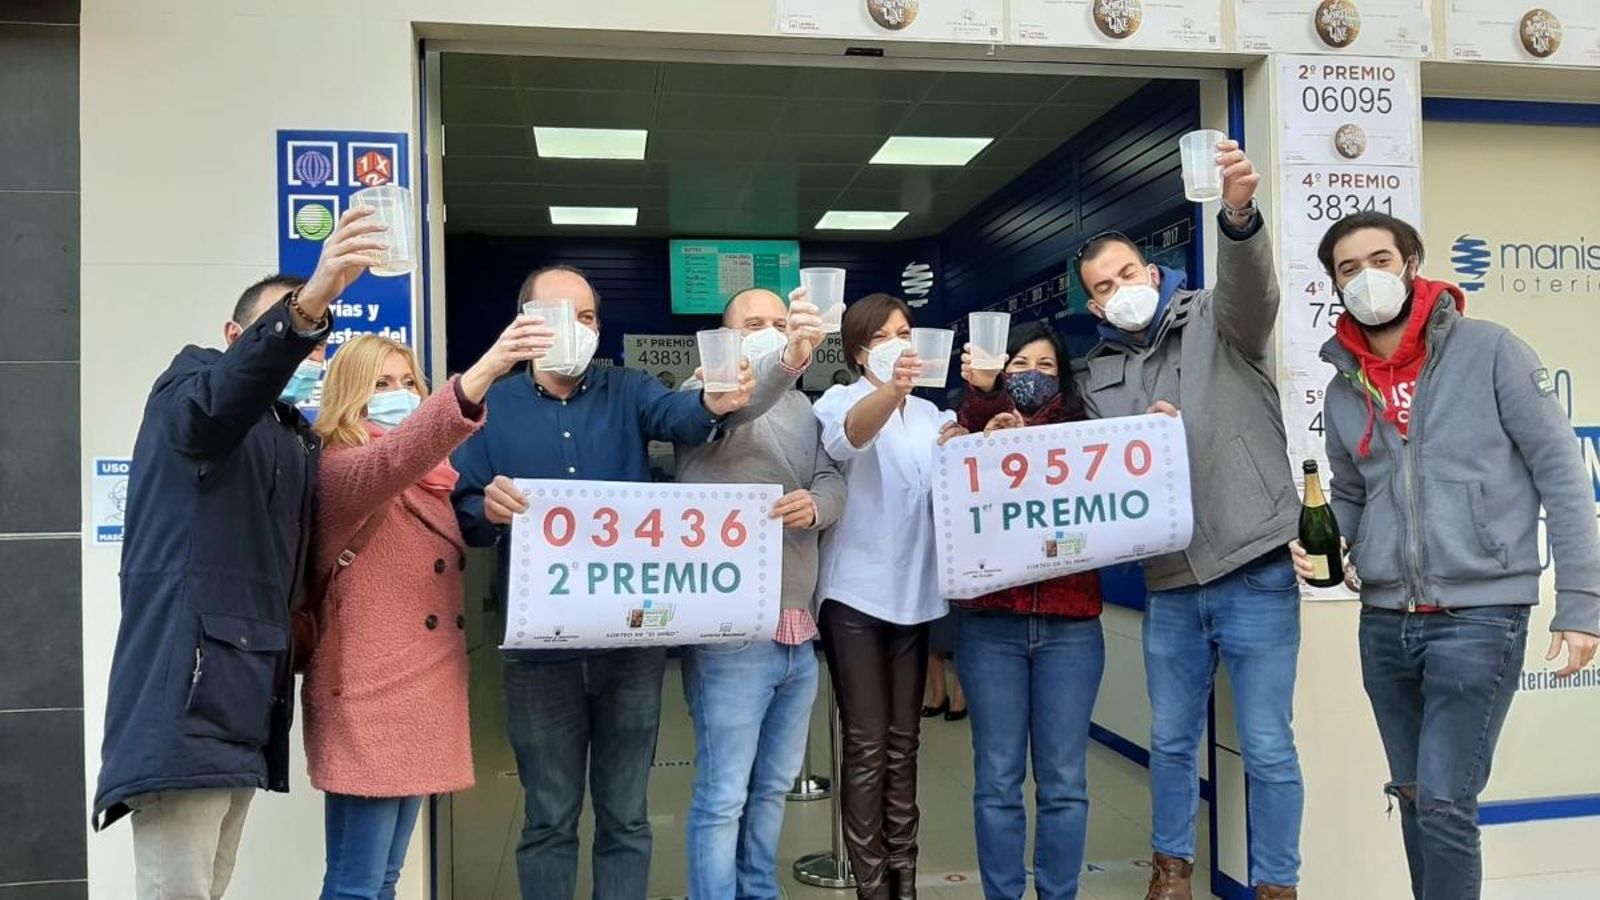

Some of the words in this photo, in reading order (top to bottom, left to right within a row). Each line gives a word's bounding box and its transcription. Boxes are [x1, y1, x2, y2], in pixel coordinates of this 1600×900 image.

[1323, 65, 1395, 82] PREMIO
[1302, 86, 1392, 114] 06095
[1328, 173, 1400, 189] PREMIO
[1501, 274, 1600, 292] loterí
[367, 304, 380, 321] y
[651, 339, 695, 348] PREMIO
[638, 350, 691, 366] 43831
[102, 463, 130, 474] USO
[964, 440, 1152, 493] 19570
[1002, 490, 1150, 531] PREMIO
[543, 506, 747, 549] 03436
[587, 561, 742, 595] PREMIO
